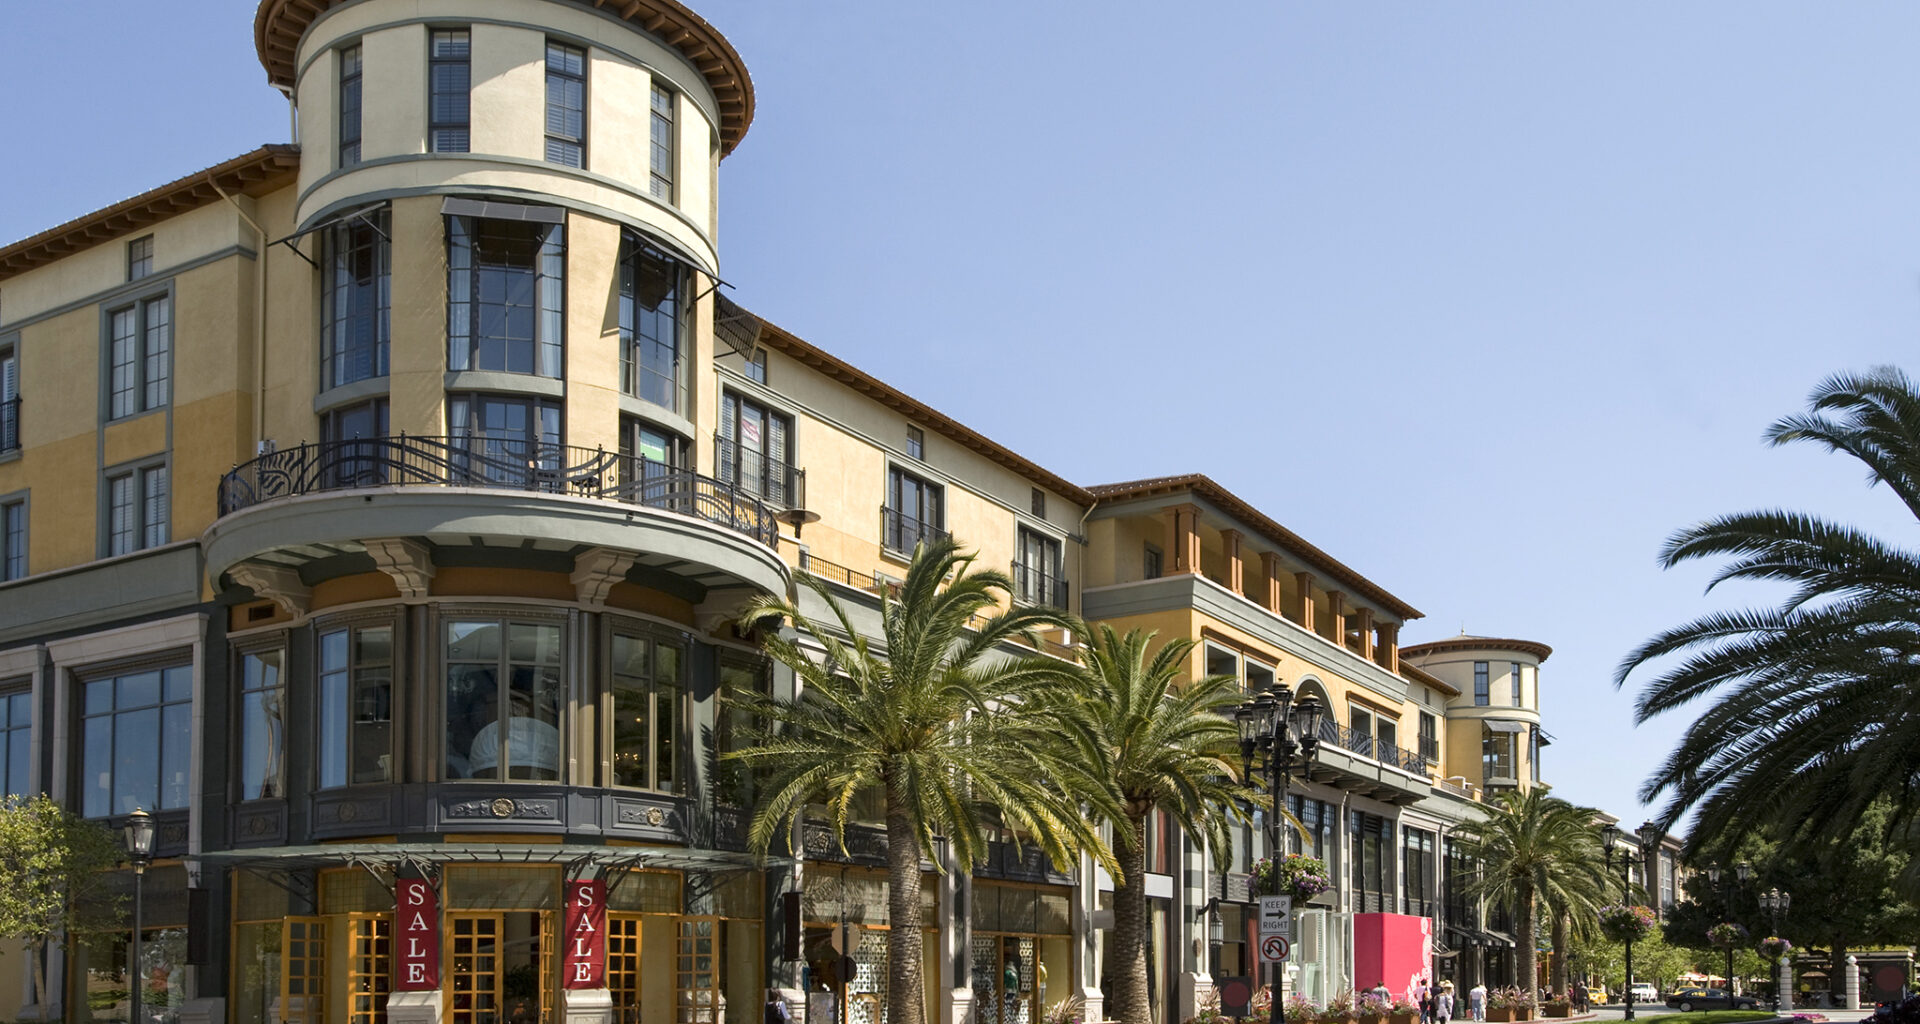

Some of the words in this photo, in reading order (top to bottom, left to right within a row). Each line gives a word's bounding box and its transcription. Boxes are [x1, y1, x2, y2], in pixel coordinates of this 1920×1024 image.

[1263, 921, 1288, 929] RIGHT
[1265, 900, 1287, 909] KEEP
[407, 884, 429, 983] SALE
[574, 886, 595, 982] SALE
